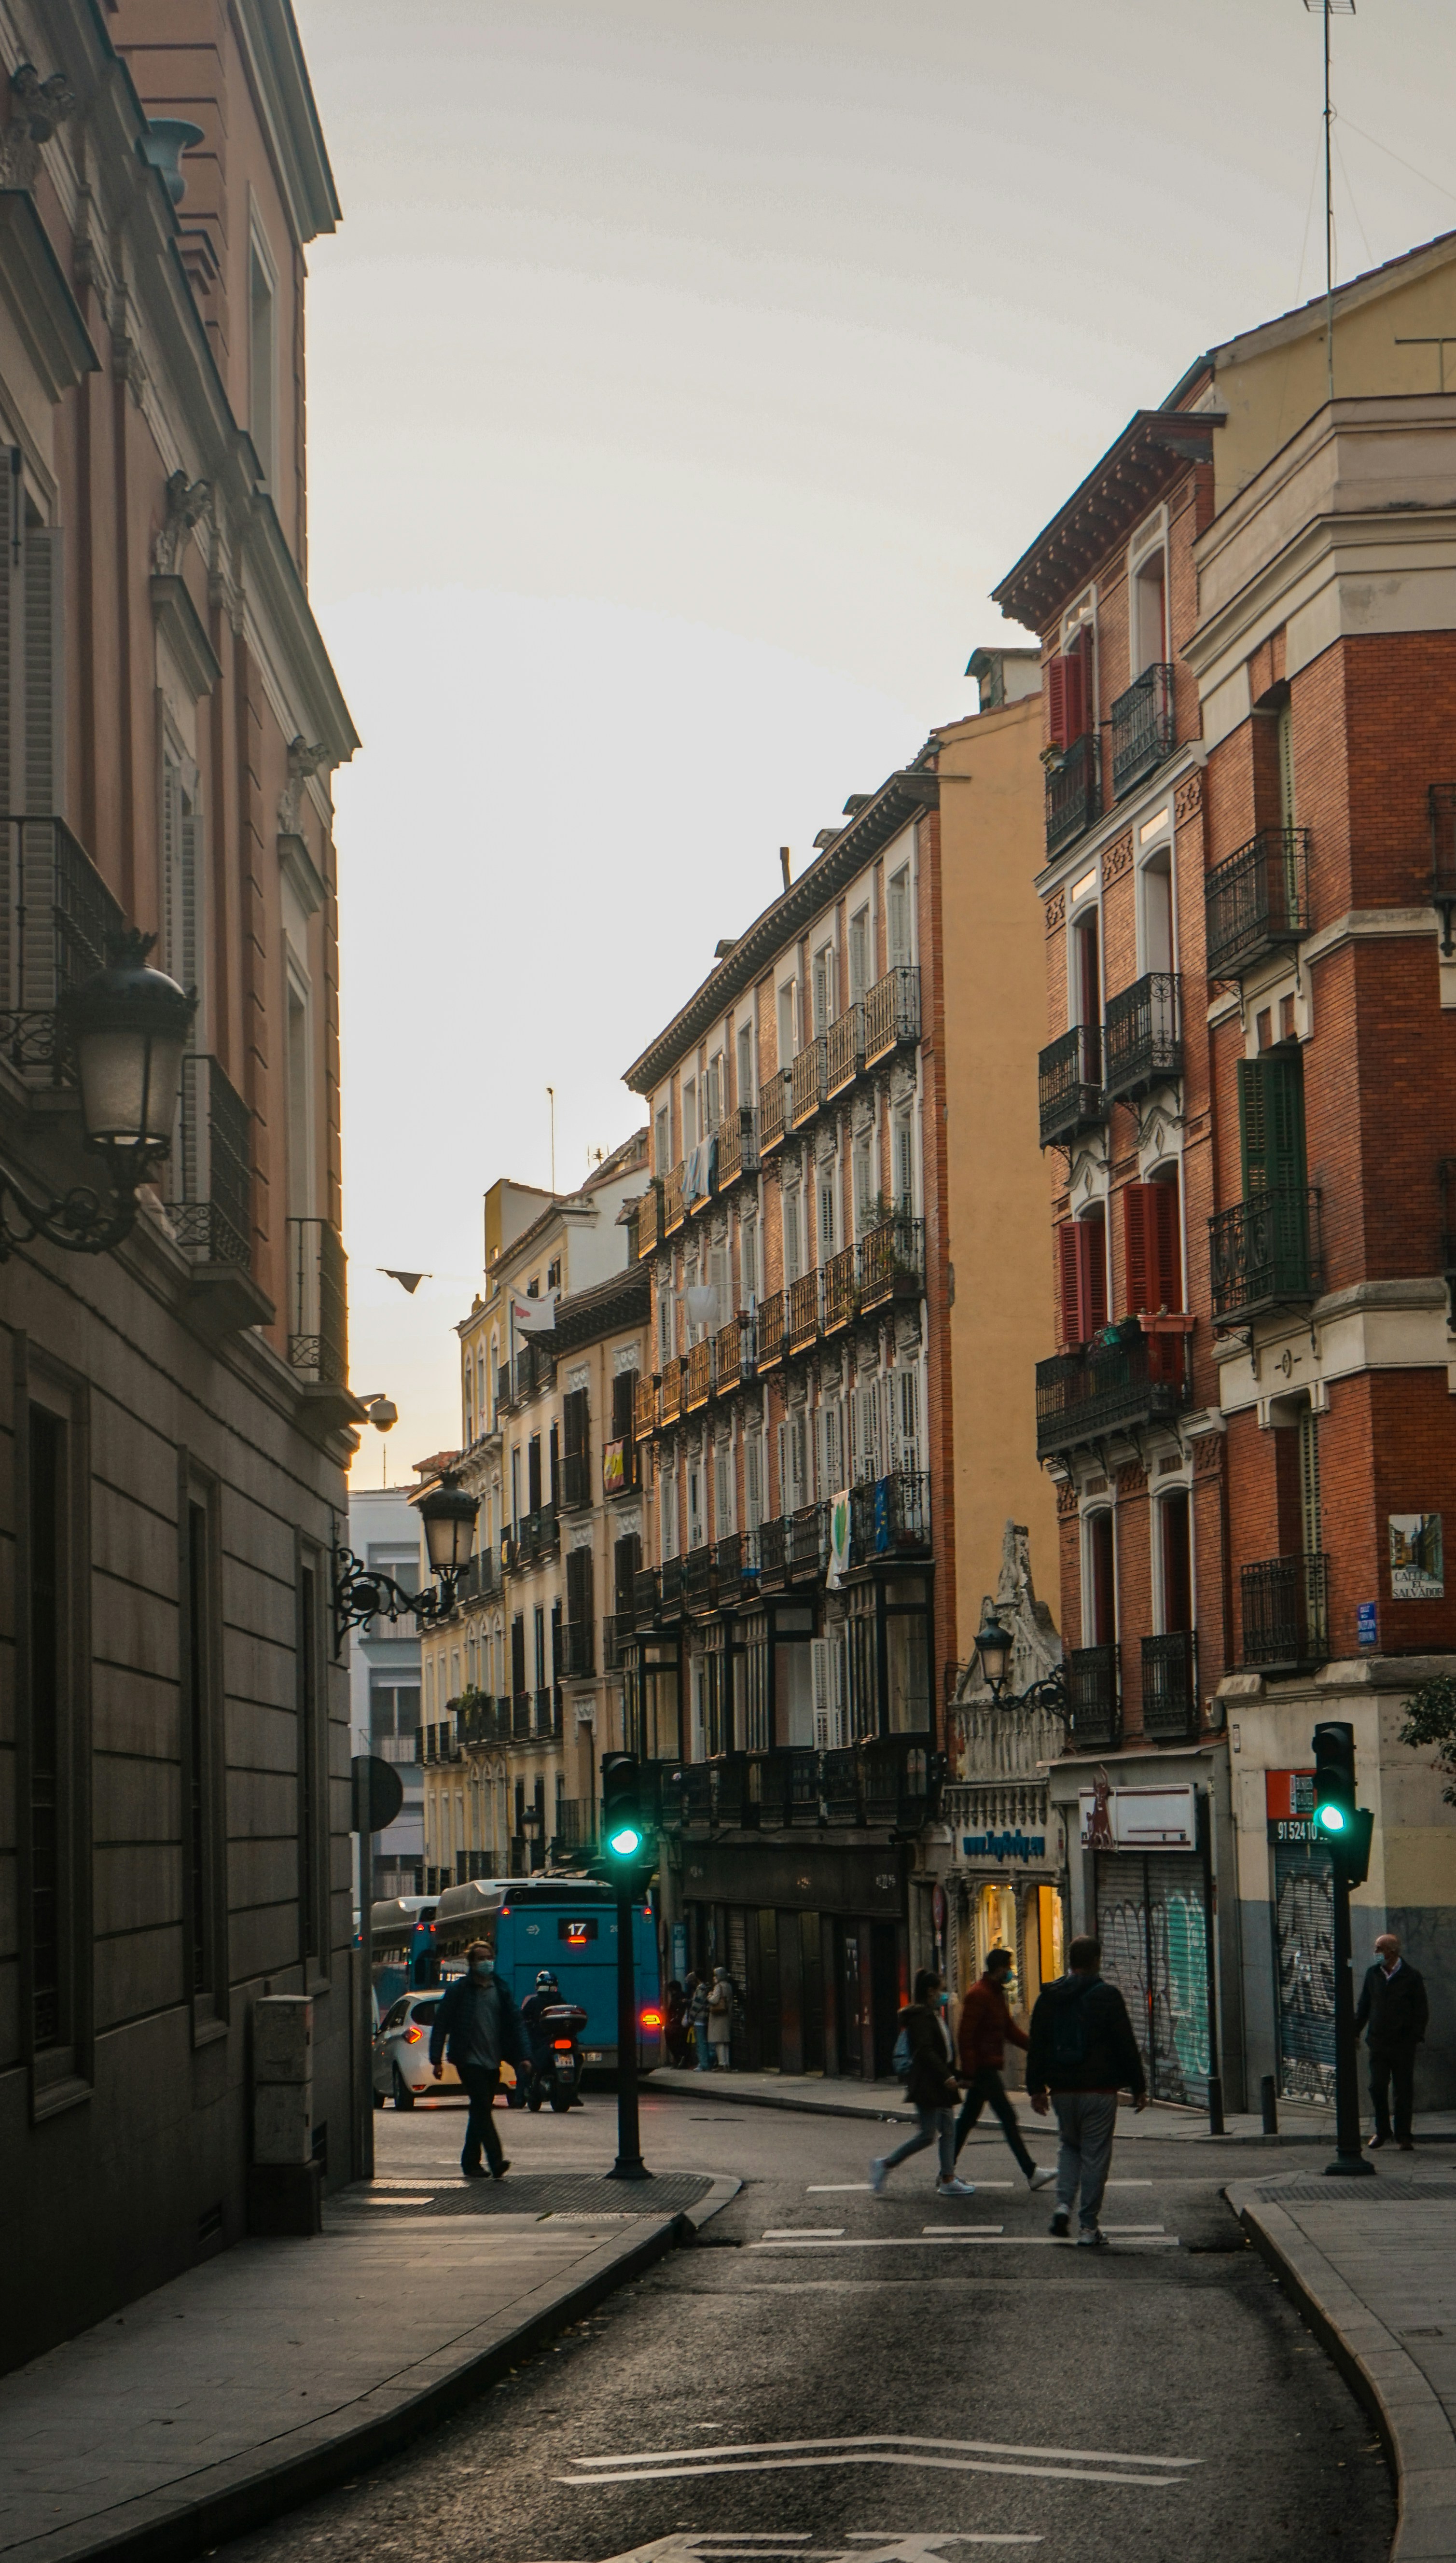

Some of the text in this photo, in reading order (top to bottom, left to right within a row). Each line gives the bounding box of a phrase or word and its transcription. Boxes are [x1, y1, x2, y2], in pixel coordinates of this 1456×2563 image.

[1395, 1572, 1425, 1581] CALLE
[1393, 1588, 1443, 1597] SALVADOR
[1278, 1822, 1288, 1840] 91
[1289, 1822, 1306, 1840] 524
[568, 1924, 586, 1935] 17
